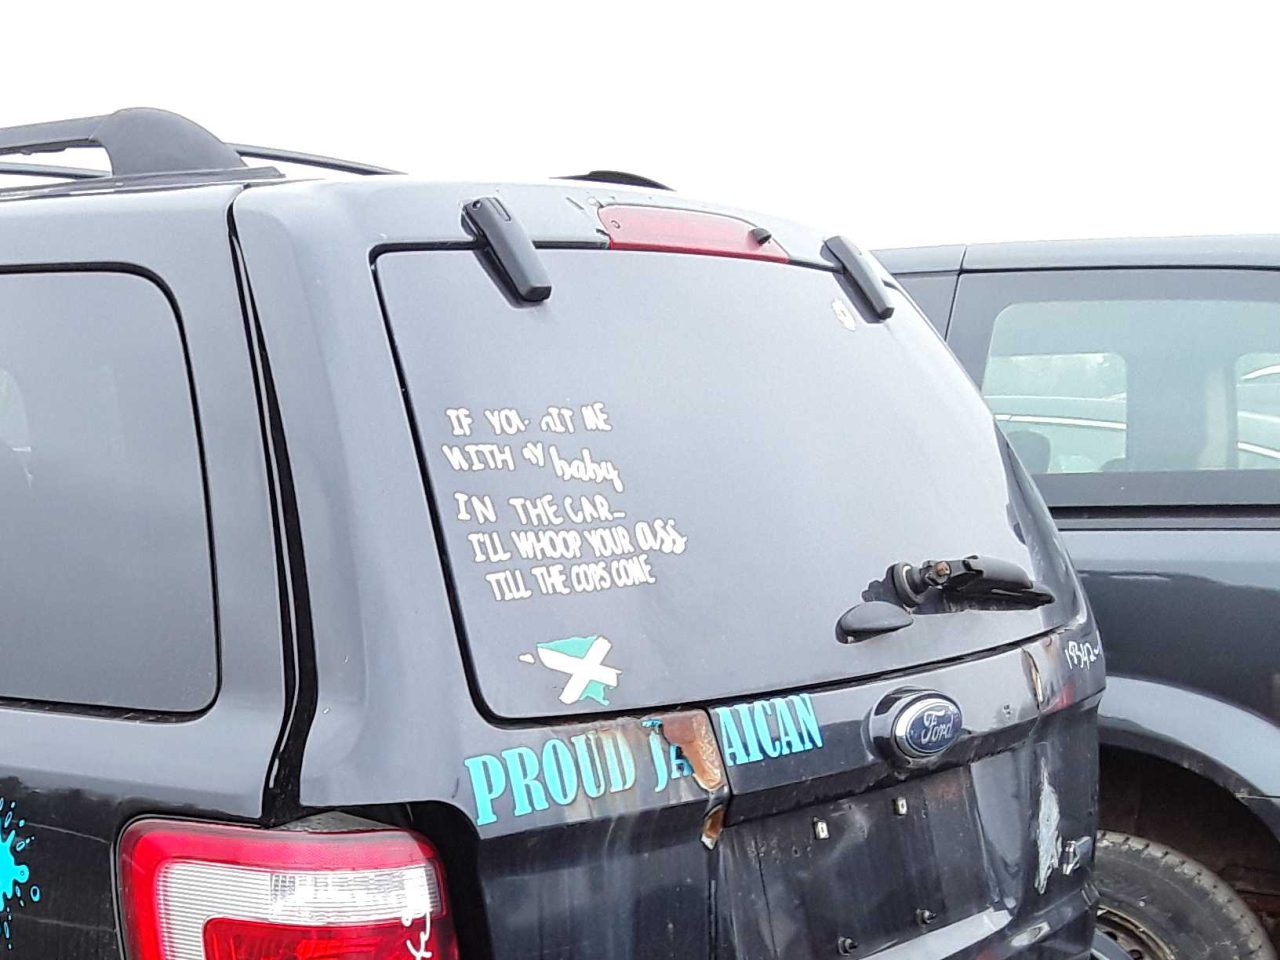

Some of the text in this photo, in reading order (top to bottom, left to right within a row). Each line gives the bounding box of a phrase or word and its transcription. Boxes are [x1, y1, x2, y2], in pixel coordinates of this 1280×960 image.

[446, 408, 472, 436] IF
[581, 402, 612, 431] ME
[454, 492, 497, 524] IN
[509, 495, 564, 526] THE
[511, 529, 582, 560] WHOOP
[583, 526, 634, 557] YOUR
[486, 554, 656, 601] TILL THE COPS COME
[920, 709, 954, 745] Ford
[464, 693, 824, 827] PROUD JAAICAN
